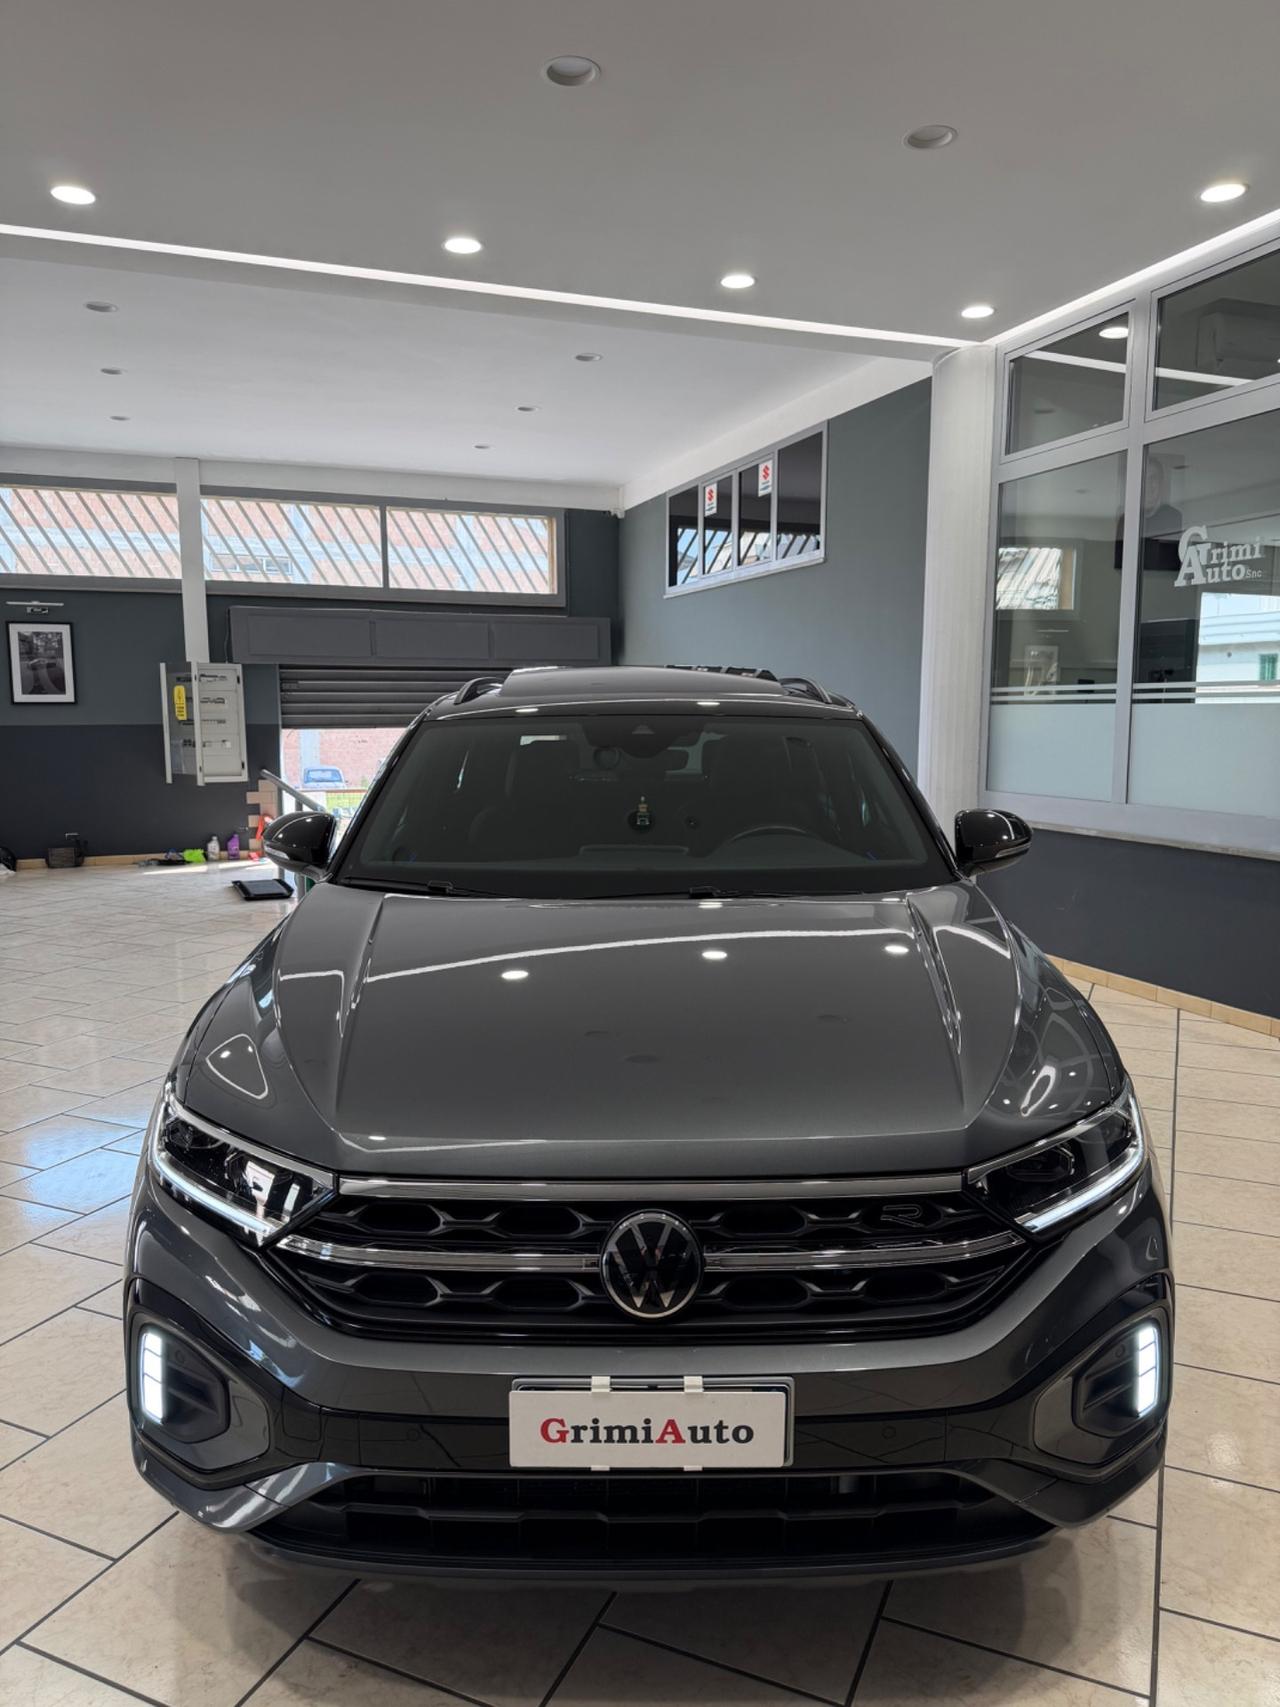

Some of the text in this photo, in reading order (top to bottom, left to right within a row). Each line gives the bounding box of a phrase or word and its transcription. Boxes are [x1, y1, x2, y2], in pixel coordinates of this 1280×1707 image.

[1174, 545, 1263, 587] Auto Snc
[1178, 525, 1263, 566] Grimi
[540, 1417, 754, 1444] GrimiAuto
